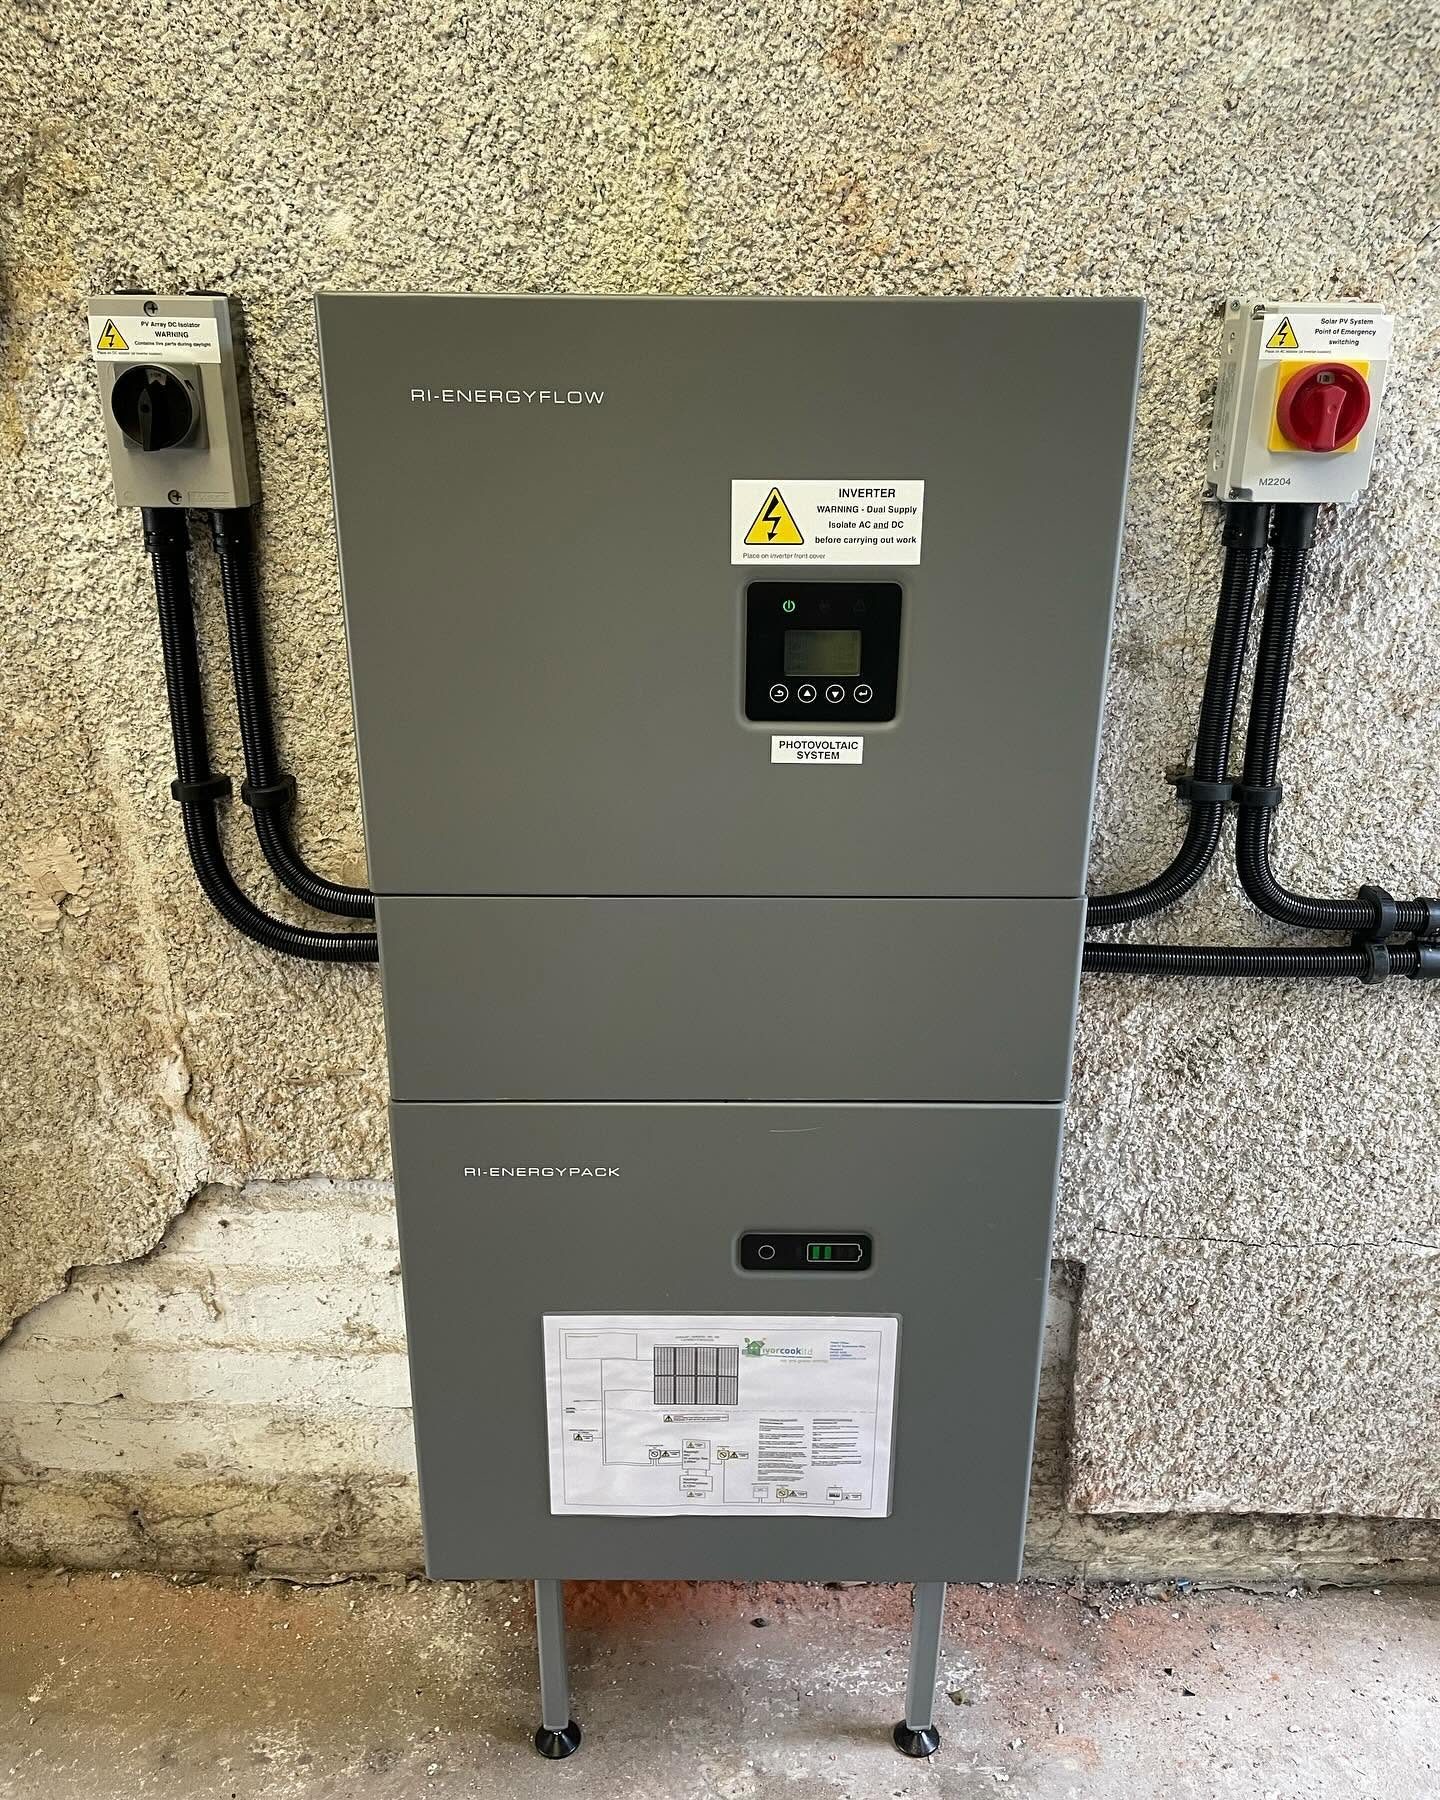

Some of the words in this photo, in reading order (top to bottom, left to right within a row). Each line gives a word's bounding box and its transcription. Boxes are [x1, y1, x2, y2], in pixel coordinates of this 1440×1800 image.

[150, 321, 167, 329] Array
[1349, 318, 1374, 326] System
[1340, 329, 1377, 337] Emergency
[410, 389, 605, 404] RI-ENERGYFLOW
[1258, 477, 1291, 486] M2204
[838, 488, 896, 498] INVERTER
[816, 505, 859, 513] WARNING
[866, 505, 886, 513] Dual
[887, 505, 918, 515] Supply
[828, 520, 857, 529] Isolate
[858, 521, 872, 529] AC
[872, 520, 889, 530] and
[891, 521, 904, 529] DC
[814, 536, 842, 544] before
[843, 536, 878, 545] carrying
[896, 536, 917, 544] work
[778, 740, 859, 750] PHOTOVOLTAIC
[796, 751, 840, 760] SYSTEM
[463, 1167, 620, 1177] RI-ENERGYPACK
